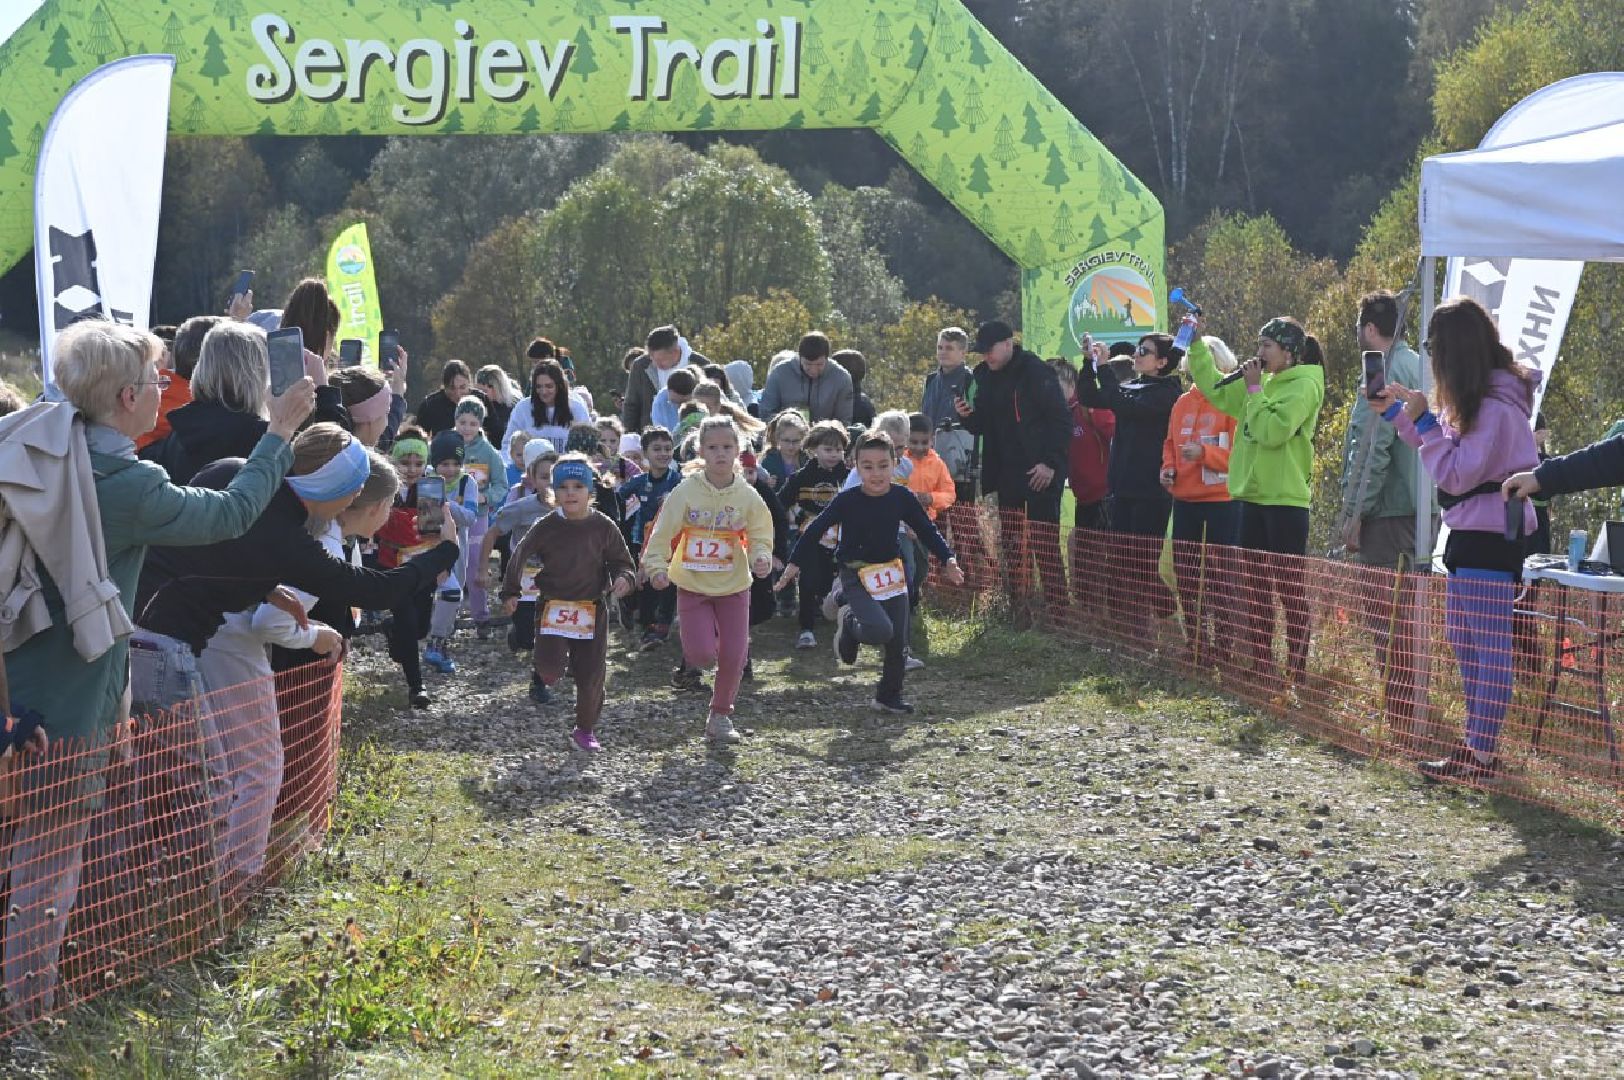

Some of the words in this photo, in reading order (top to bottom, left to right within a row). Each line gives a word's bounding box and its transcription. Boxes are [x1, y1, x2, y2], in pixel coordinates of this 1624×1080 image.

[247, 14, 576, 126] Sergiev
[609, 14, 802, 101] Trail
[1064, 250, 1125, 288] SERGIEV
[1124, 252, 1156, 287] TRAIL
[1515, 285, 1560, 370] ХНИ
[695, 541, 720, 558] 12
[874, 570, 894, 588] 11
[556, 609, 579, 625] 54
